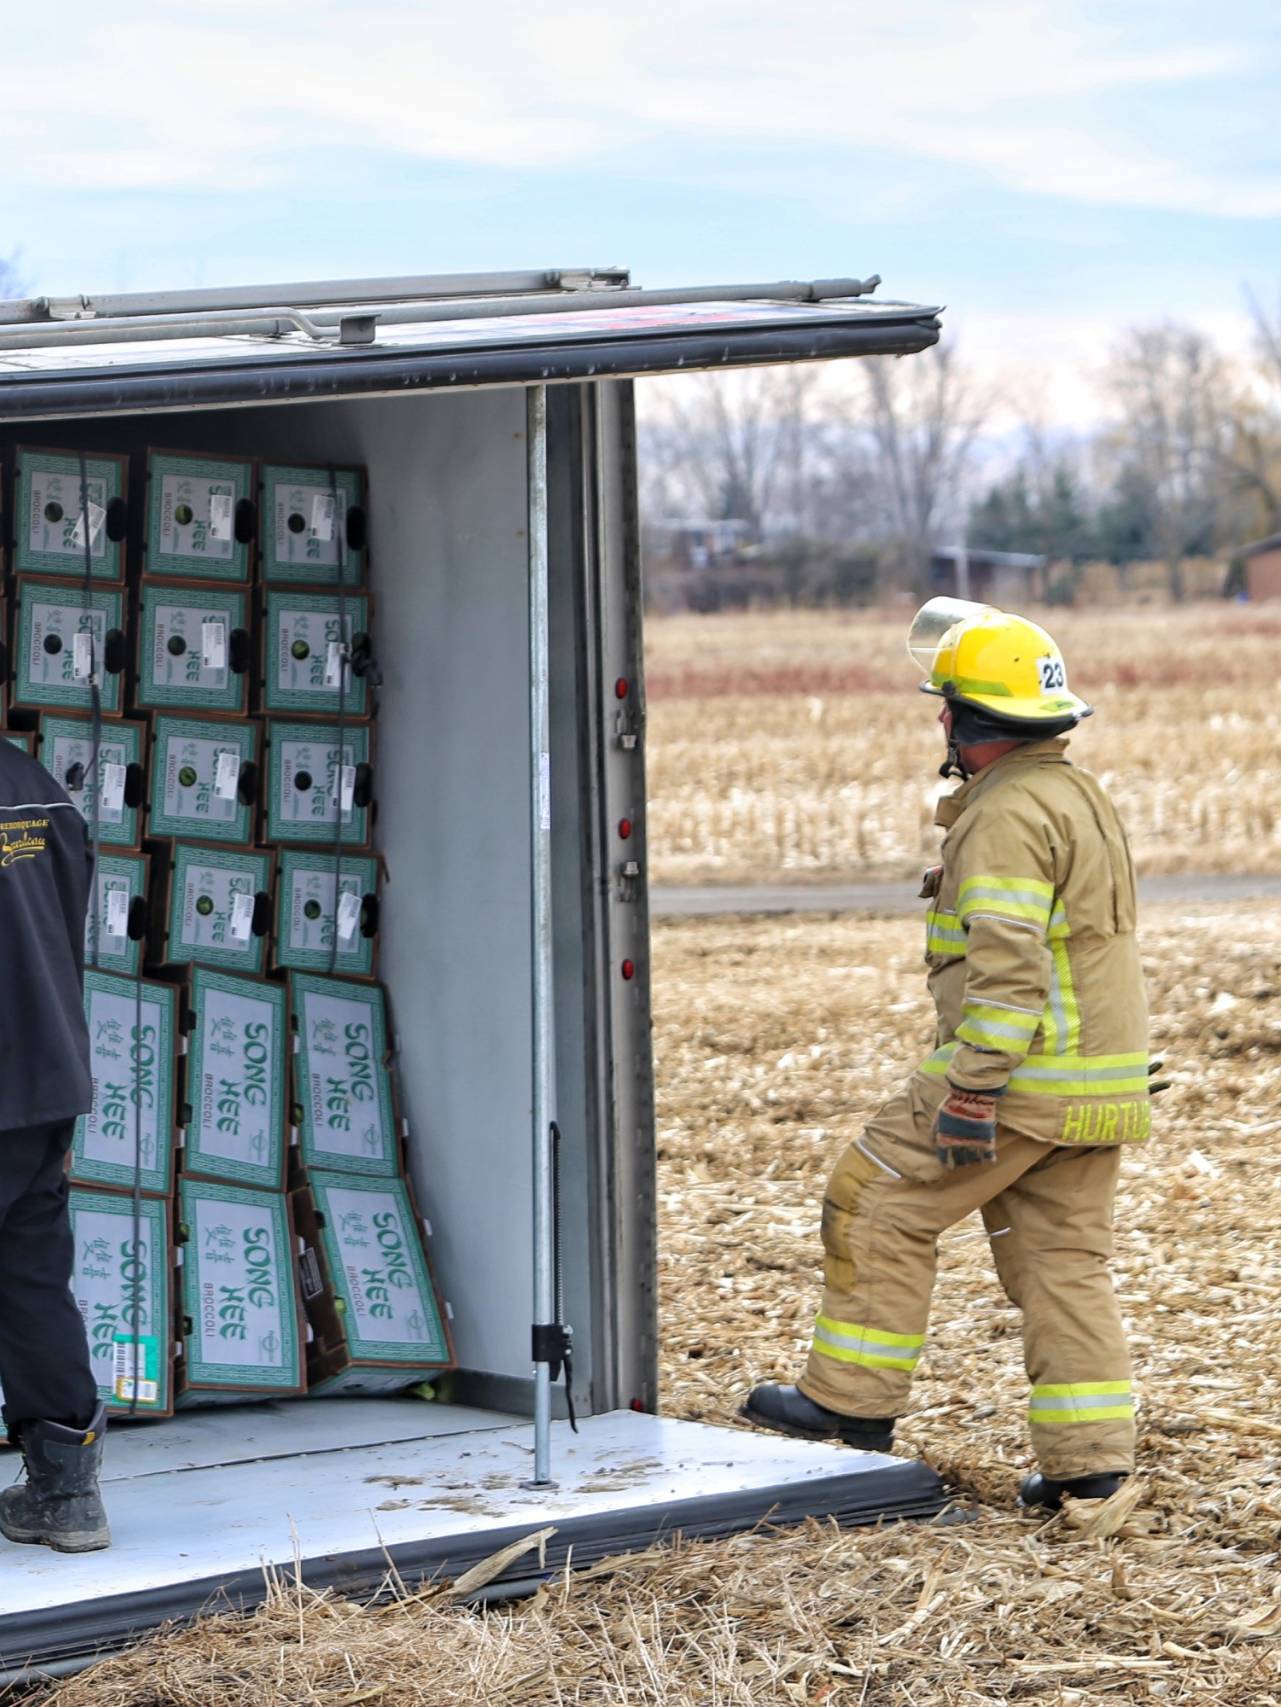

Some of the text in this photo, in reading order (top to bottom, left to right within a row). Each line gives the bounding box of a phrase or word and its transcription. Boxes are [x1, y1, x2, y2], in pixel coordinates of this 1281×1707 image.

[1043, 663, 1064, 689] 23
[130, 1024, 156, 1110] SONG
[244, 1021, 269, 1107] SONG
[344, 1022, 374, 1103] SONG
[102, 1082, 128, 1141] HEE
[203, 1073, 214, 1129] BROCCOLI
[216, 1078, 242, 1137] HEE
[311, 1073, 324, 1127] BROCCOLI
[325, 1076, 351, 1133] HEE
[243, 1226, 275, 1311] SONG
[373, 1211, 413, 1289] SONG
[203, 1282, 216, 1338] BROCCOLI
[218, 1284, 247, 1343] HEE
[346, 1265, 365, 1317] BROCCOLI
[362, 1267, 396, 1321] HEE
[92, 1301, 118, 1363] HEE
